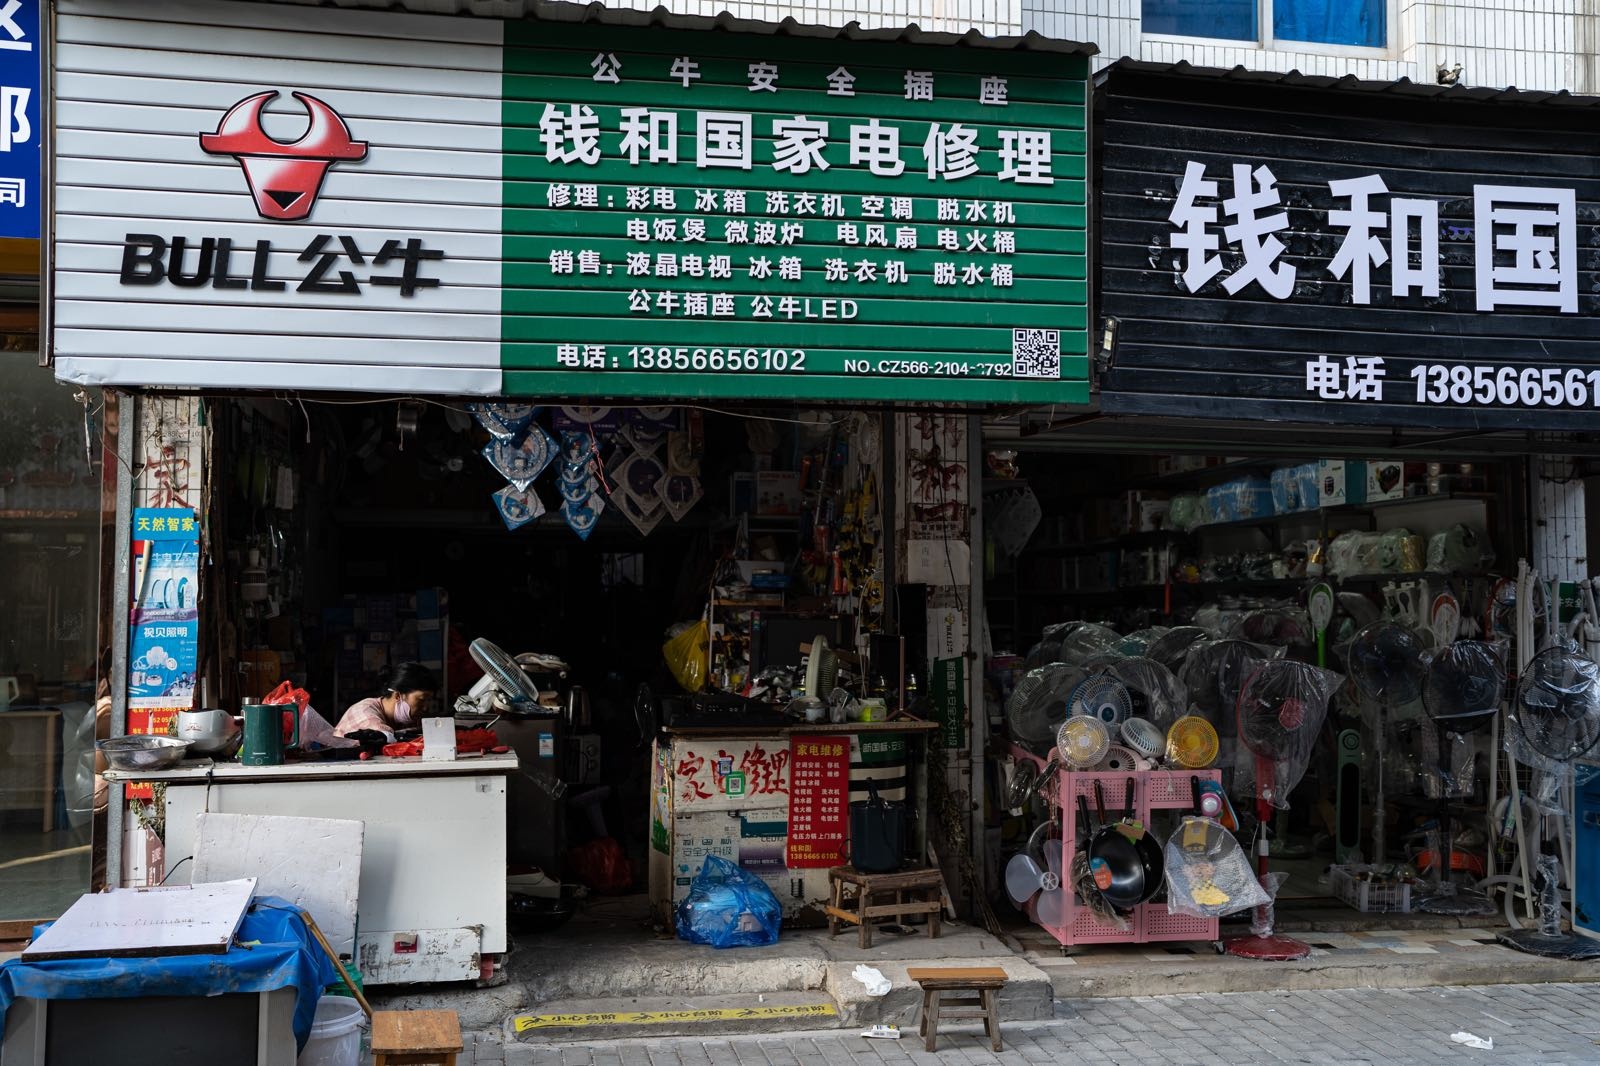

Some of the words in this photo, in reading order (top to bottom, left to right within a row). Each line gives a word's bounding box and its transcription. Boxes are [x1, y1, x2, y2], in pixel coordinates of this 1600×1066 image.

[591, 52, 1008, 105] 公牛安全插座
[539, 103, 1054, 184] 钱和国家电修理
[694, 189, 746, 214] 冰箱
[766, 190, 845, 217] 洗衣机
[861, 195, 913, 219] 空调
[937, 199, 1016, 223] 脱水机
[626, 218, 706, 242] 电饭煲
[725, 220, 804, 245] 微波炉
[837, 223, 917, 249] 电风扇
[937, 229, 1016, 253] 电火桶
[1168, 160, 1578, 313] 钱和国
[749, 256, 801, 280] 冰箱
[825, 258, 908, 283] 洗衣机
[934, 262, 1013, 286] 脱水桶
[628, 289, 735, 316] 公牛插座
[750, 296, 858, 319] 公牛LED
[1305, 354, 1386, 400] 电话
[1410, 364, 1600, 407] 138566561
[137, 517, 195, 532] 天然智家
[143, 627, 188, 638] 视贝照明
[797, 744, 844, 757] 家电维修
